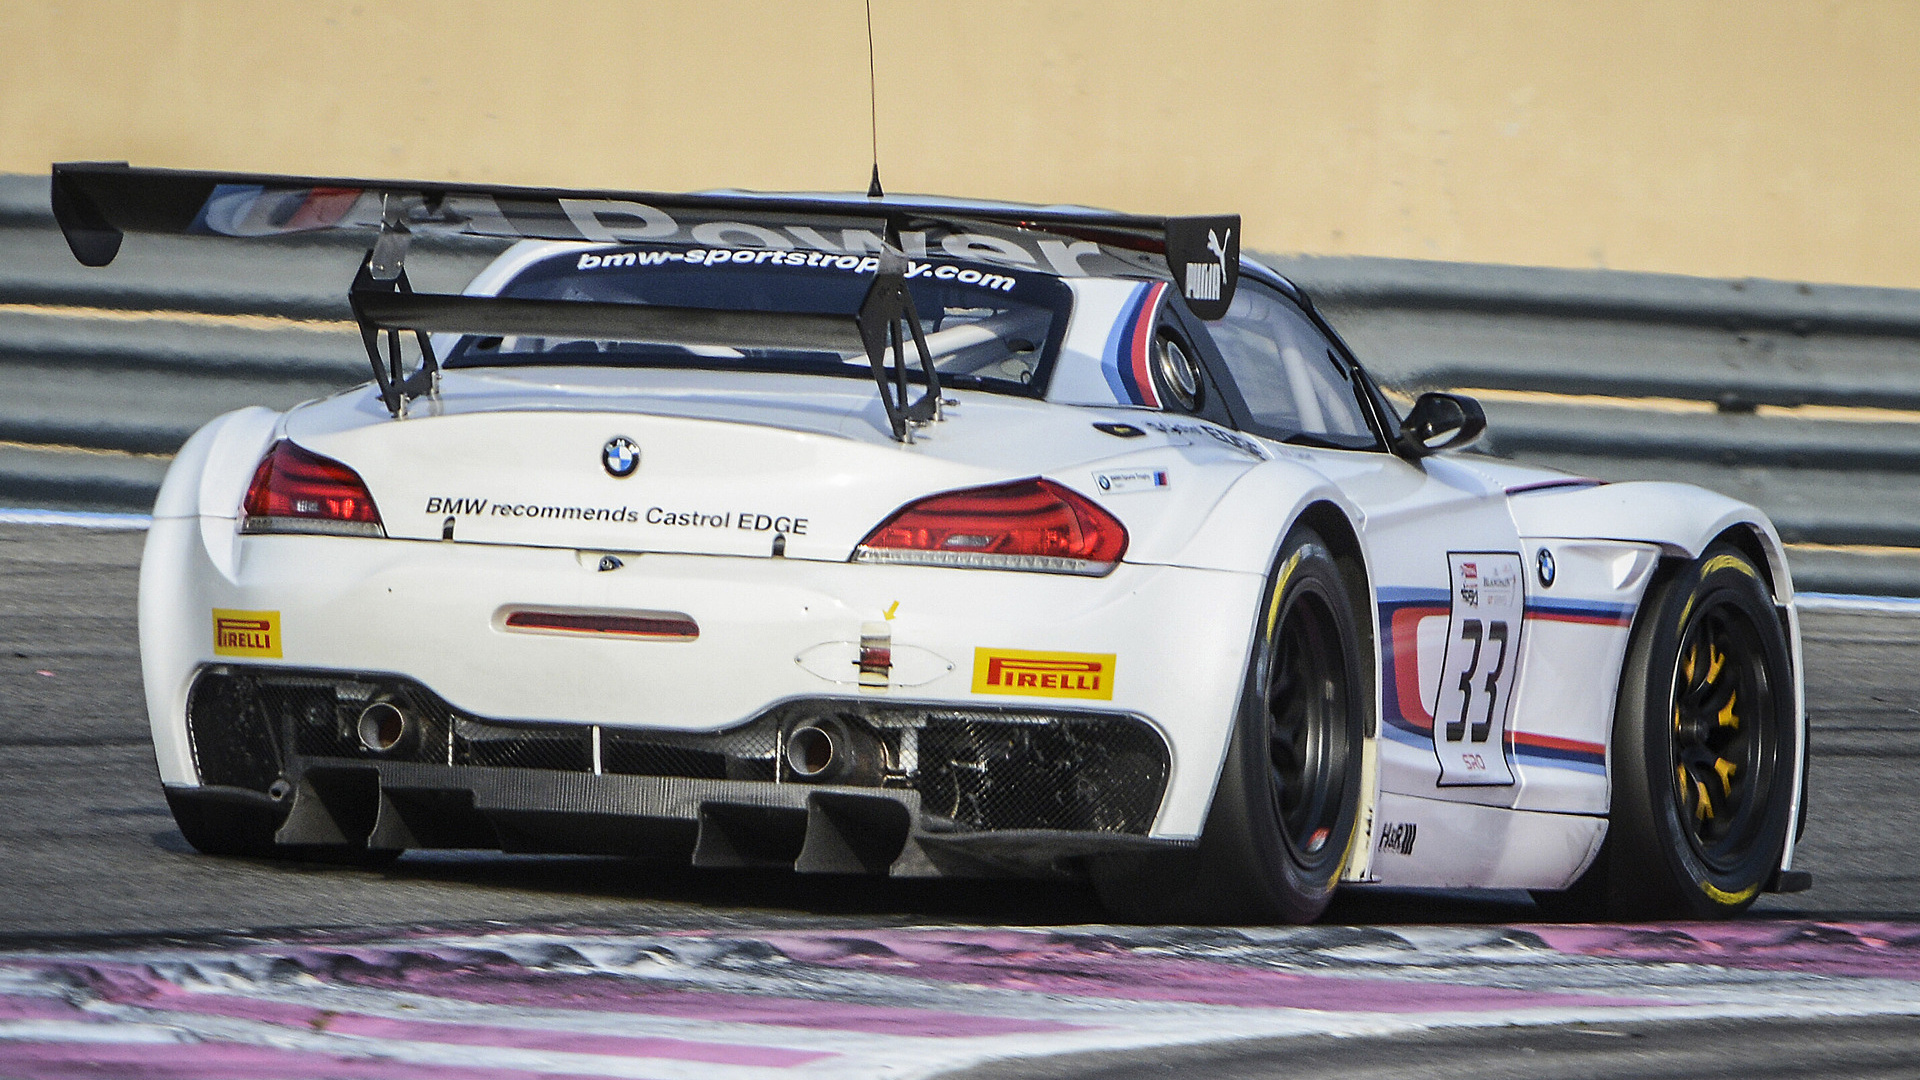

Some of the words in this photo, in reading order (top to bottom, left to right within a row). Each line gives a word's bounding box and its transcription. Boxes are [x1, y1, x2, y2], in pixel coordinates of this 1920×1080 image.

[576, 247, 1017, 293] bmw-sportstropy.com
[425, 497, 488, 516] BMW
[491, 501, 639, 523] recommends
[647, 506, 730, 528] Castrol
[737, 514, 809, 535] EDGE
[217, 618, 271, 649] PIRELLI
[986, 656, 1102, 691] PIRELLI
[1446, 618, 1508, 743] 33
